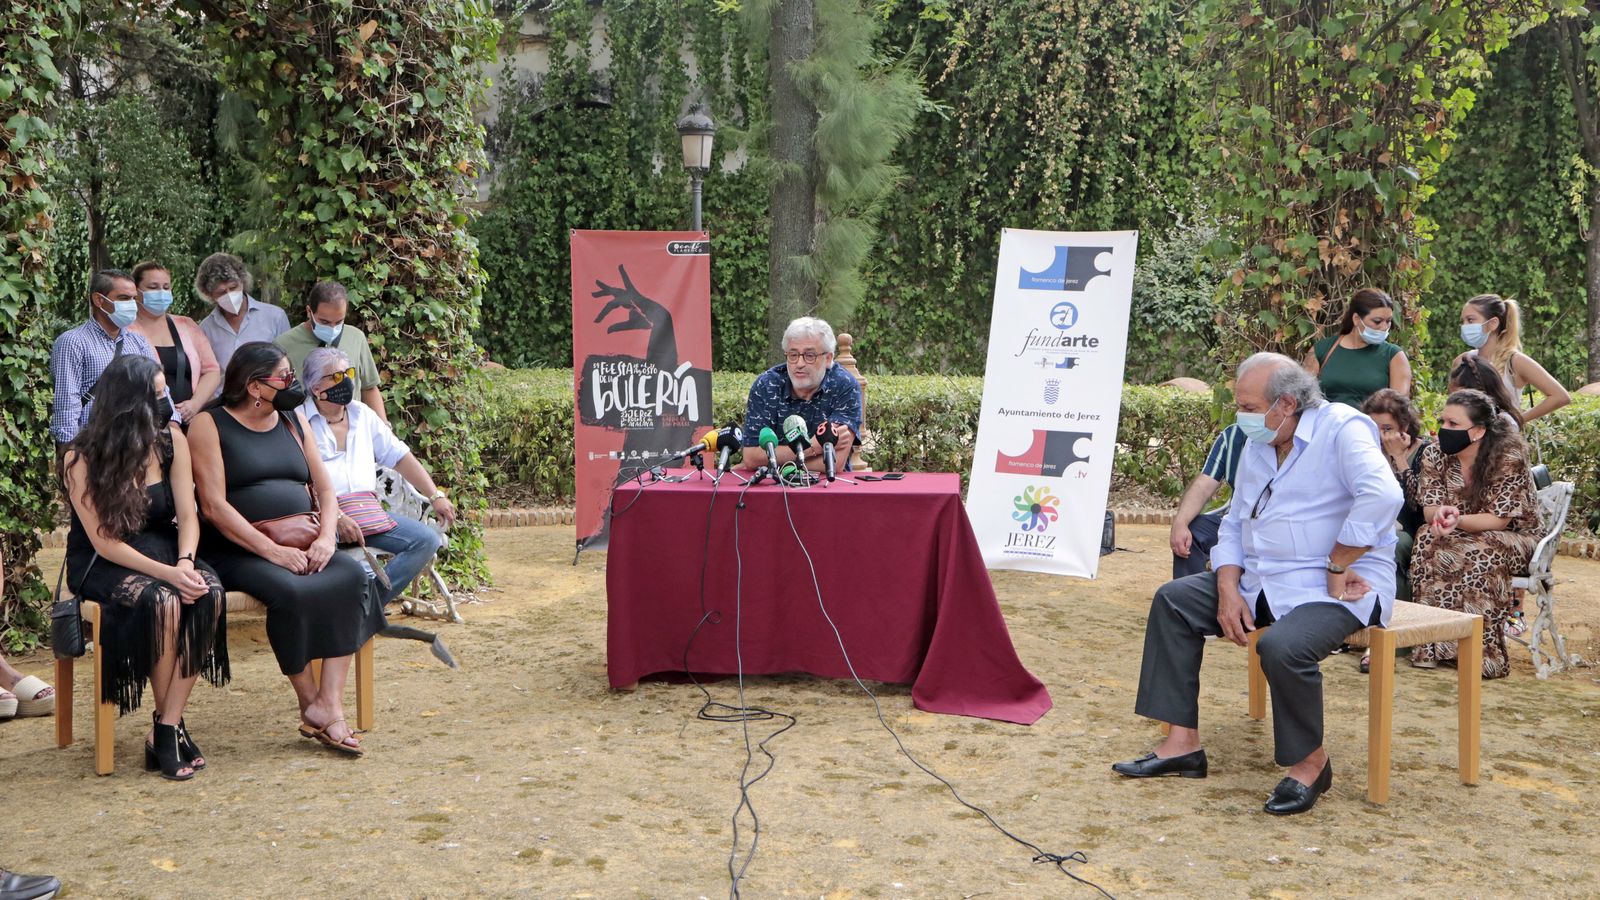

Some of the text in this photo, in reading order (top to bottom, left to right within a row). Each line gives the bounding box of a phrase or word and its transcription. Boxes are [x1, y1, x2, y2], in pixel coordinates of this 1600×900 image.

[1014, 328, 1099, 358] fundarte
[998, 407, 1101, 421] Ayuntamiento de Jerez
[1004, 532, 1056, 550] JEREZ
